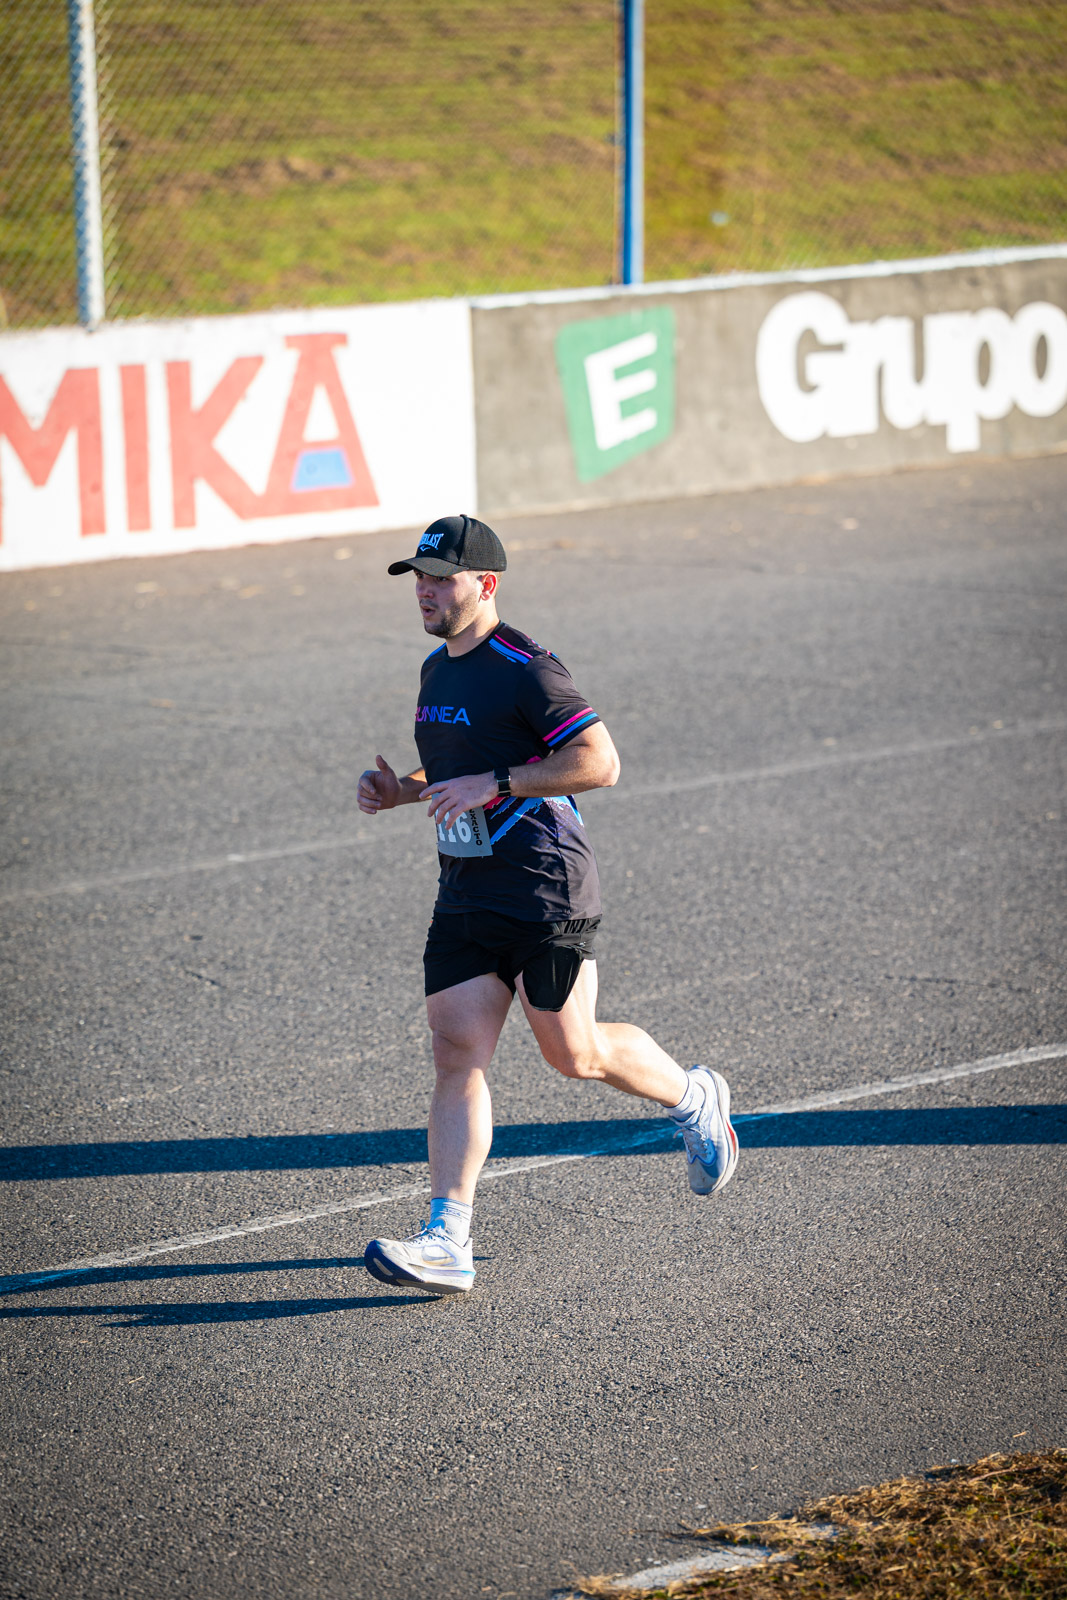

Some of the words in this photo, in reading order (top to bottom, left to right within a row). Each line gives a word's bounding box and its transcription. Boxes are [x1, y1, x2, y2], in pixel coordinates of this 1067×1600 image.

[0, 333, 380, 548] MIKA
[584, 331, 657, 451] E
[756, 291, 1067, 452] Grupo
[415, 705, 471, 726] UNNEA
